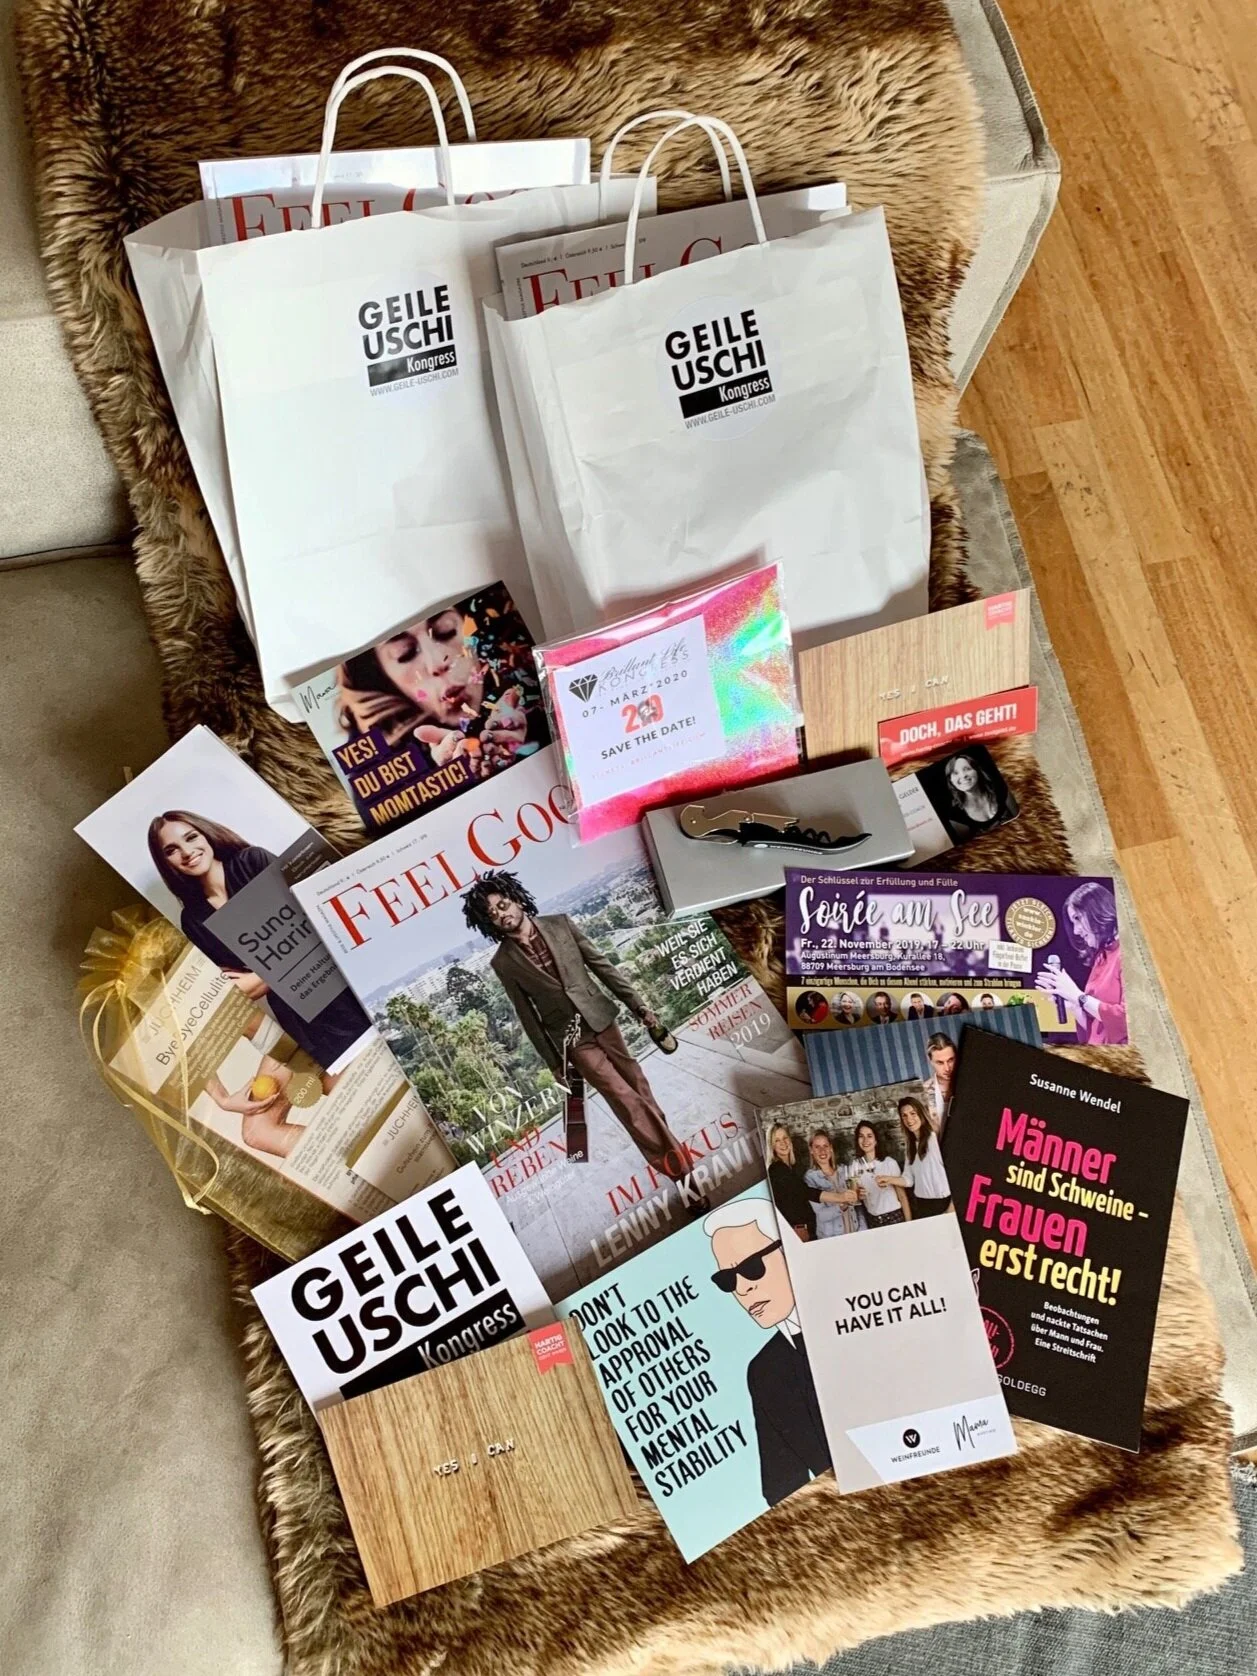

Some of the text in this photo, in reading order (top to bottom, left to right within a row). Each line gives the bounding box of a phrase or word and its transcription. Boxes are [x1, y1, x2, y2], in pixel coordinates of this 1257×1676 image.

[358, 285, 450, 330] GEILE
[362, 315, 454, 360] USCHI
[665, 309, 759, 360] GEILE
[369, 368, 459, 397] WWW.GEILE-USCHI.COM
[406, 350, 456, 374] Kongress
[671, 340, 766, 391] USCHI
[684, 393, 776, 430] WWW.GEILE-USCHI.COM
[719, 377, 770, 403] Kongress
[924, 675, 949, 688] CAN
[601, 740, 632, 760] SAVE
[634, 730, 658, 746] THE
[660, 715, 696, 736] DATE!
[899, 720, 942, 745] DOCH,
[944, 712, 973, 734] DAS
[975, 702, 1017, 726] GEHT!
[336, 735, 380, 770] YES!
[353, 750, 419, 799] DU BIST
[369, 759, 469, 827] MOMTASTIC!
[322, 850, 482, 951] FEEL
[466, 784, 577, 868] GOO
[800, 875, 959, 887] Der Schlüssel zur Erfüllung und Fülle
[238, 904, 297, 953] Suna
[799, 886, 999, 937] Soirée am See
[255, 912, 313, 971] Harir
[655, 919, 708, 958] WEIL SIE
[671, 932, 718, 971] ES SICH
[800, 938, 819, 950] Fr.,
[821, 938, 837, 949] 22.
[839, 939, 893, 950] November
[896, 940, 924, 950] 2019,
[927, 940, 938, 949] 17
[951, 941, 963, 950] 22
[965, 940, 986, 950] Uhr
[800, 951, 848, 961] Augustinum
[850, 952, 896, 962] Meersburg,
[290, 953, 331, 992] Deine Haltu
[670, 946, 728, 991] VERDIENT
[696, 961, 738, 996] HABEN
[800, 962, 825, 971] 88709
[826, 962, 870, 972] Meersburg
[886, 963, 926, 971] Bodensee
[300, 988, 313, 1000] das
[688, 983, 753, 1032] SOMMER
[707, 1000, 762, 1041] REISEN
[730, 1012, 772, 1049] 2019
[306, 1077, 316, 1089] ml
[472, 1085, 531, 1124] VON
[1029, 1073, 1122, 1114] Susanne Wendel
[488, 1134, 568, 1201] REBEN
[606, 1174, 646, 1217] IM
[645, 1111, 741, 1191] FOKUS
[995, 1106, 1117, 1185] Männer
[1006, 1160, 1048, 1193] sind
[1048, 1171, 1135, 1221] Schweine
[590, 1189, 673, 1268] LENNY
[965, 1173, 1088, 1258] Frauen
[291, 1188, 473, 1322] GEILE
[979, 1239, 1122, 1306] erst recht!
[312, 1237, 501, 1375] USCHI
[569, 1282, 627, 1332] DON'T
[588, 1275, 699, 1362] LOOK TO THE
[835, 1297, 947, 1336] HAVE IT ALL!
[845, 1281, 928, 1312] YOU CAN
[1043, 1301, 1100, 1325] Beobachtungen
[417, 1301, 518, 1369] Kongress
[1030, 1311, 1109, 1341] und nackte Tatsachen
[1030, 1323, 1104, 1353] über Mann und Frau.
[598, 1316, 694, 1389] APPROVAL
[1034, 1337, 1097, 1363] Eine Streitschrift
[611, 1338, 711, 1414] OF OTHERS
[624, 1370, 718, 1443] FOR YOUR
[434, 1459, 460, 1477] YES
[487, 1439, 515, 1457] CAN
[640, 1408, 719, 1470] MENTAL
[655, 1420, 748, 1497] STABILITY
[890, 1446, 941, 1463] WEINFREUNDE
